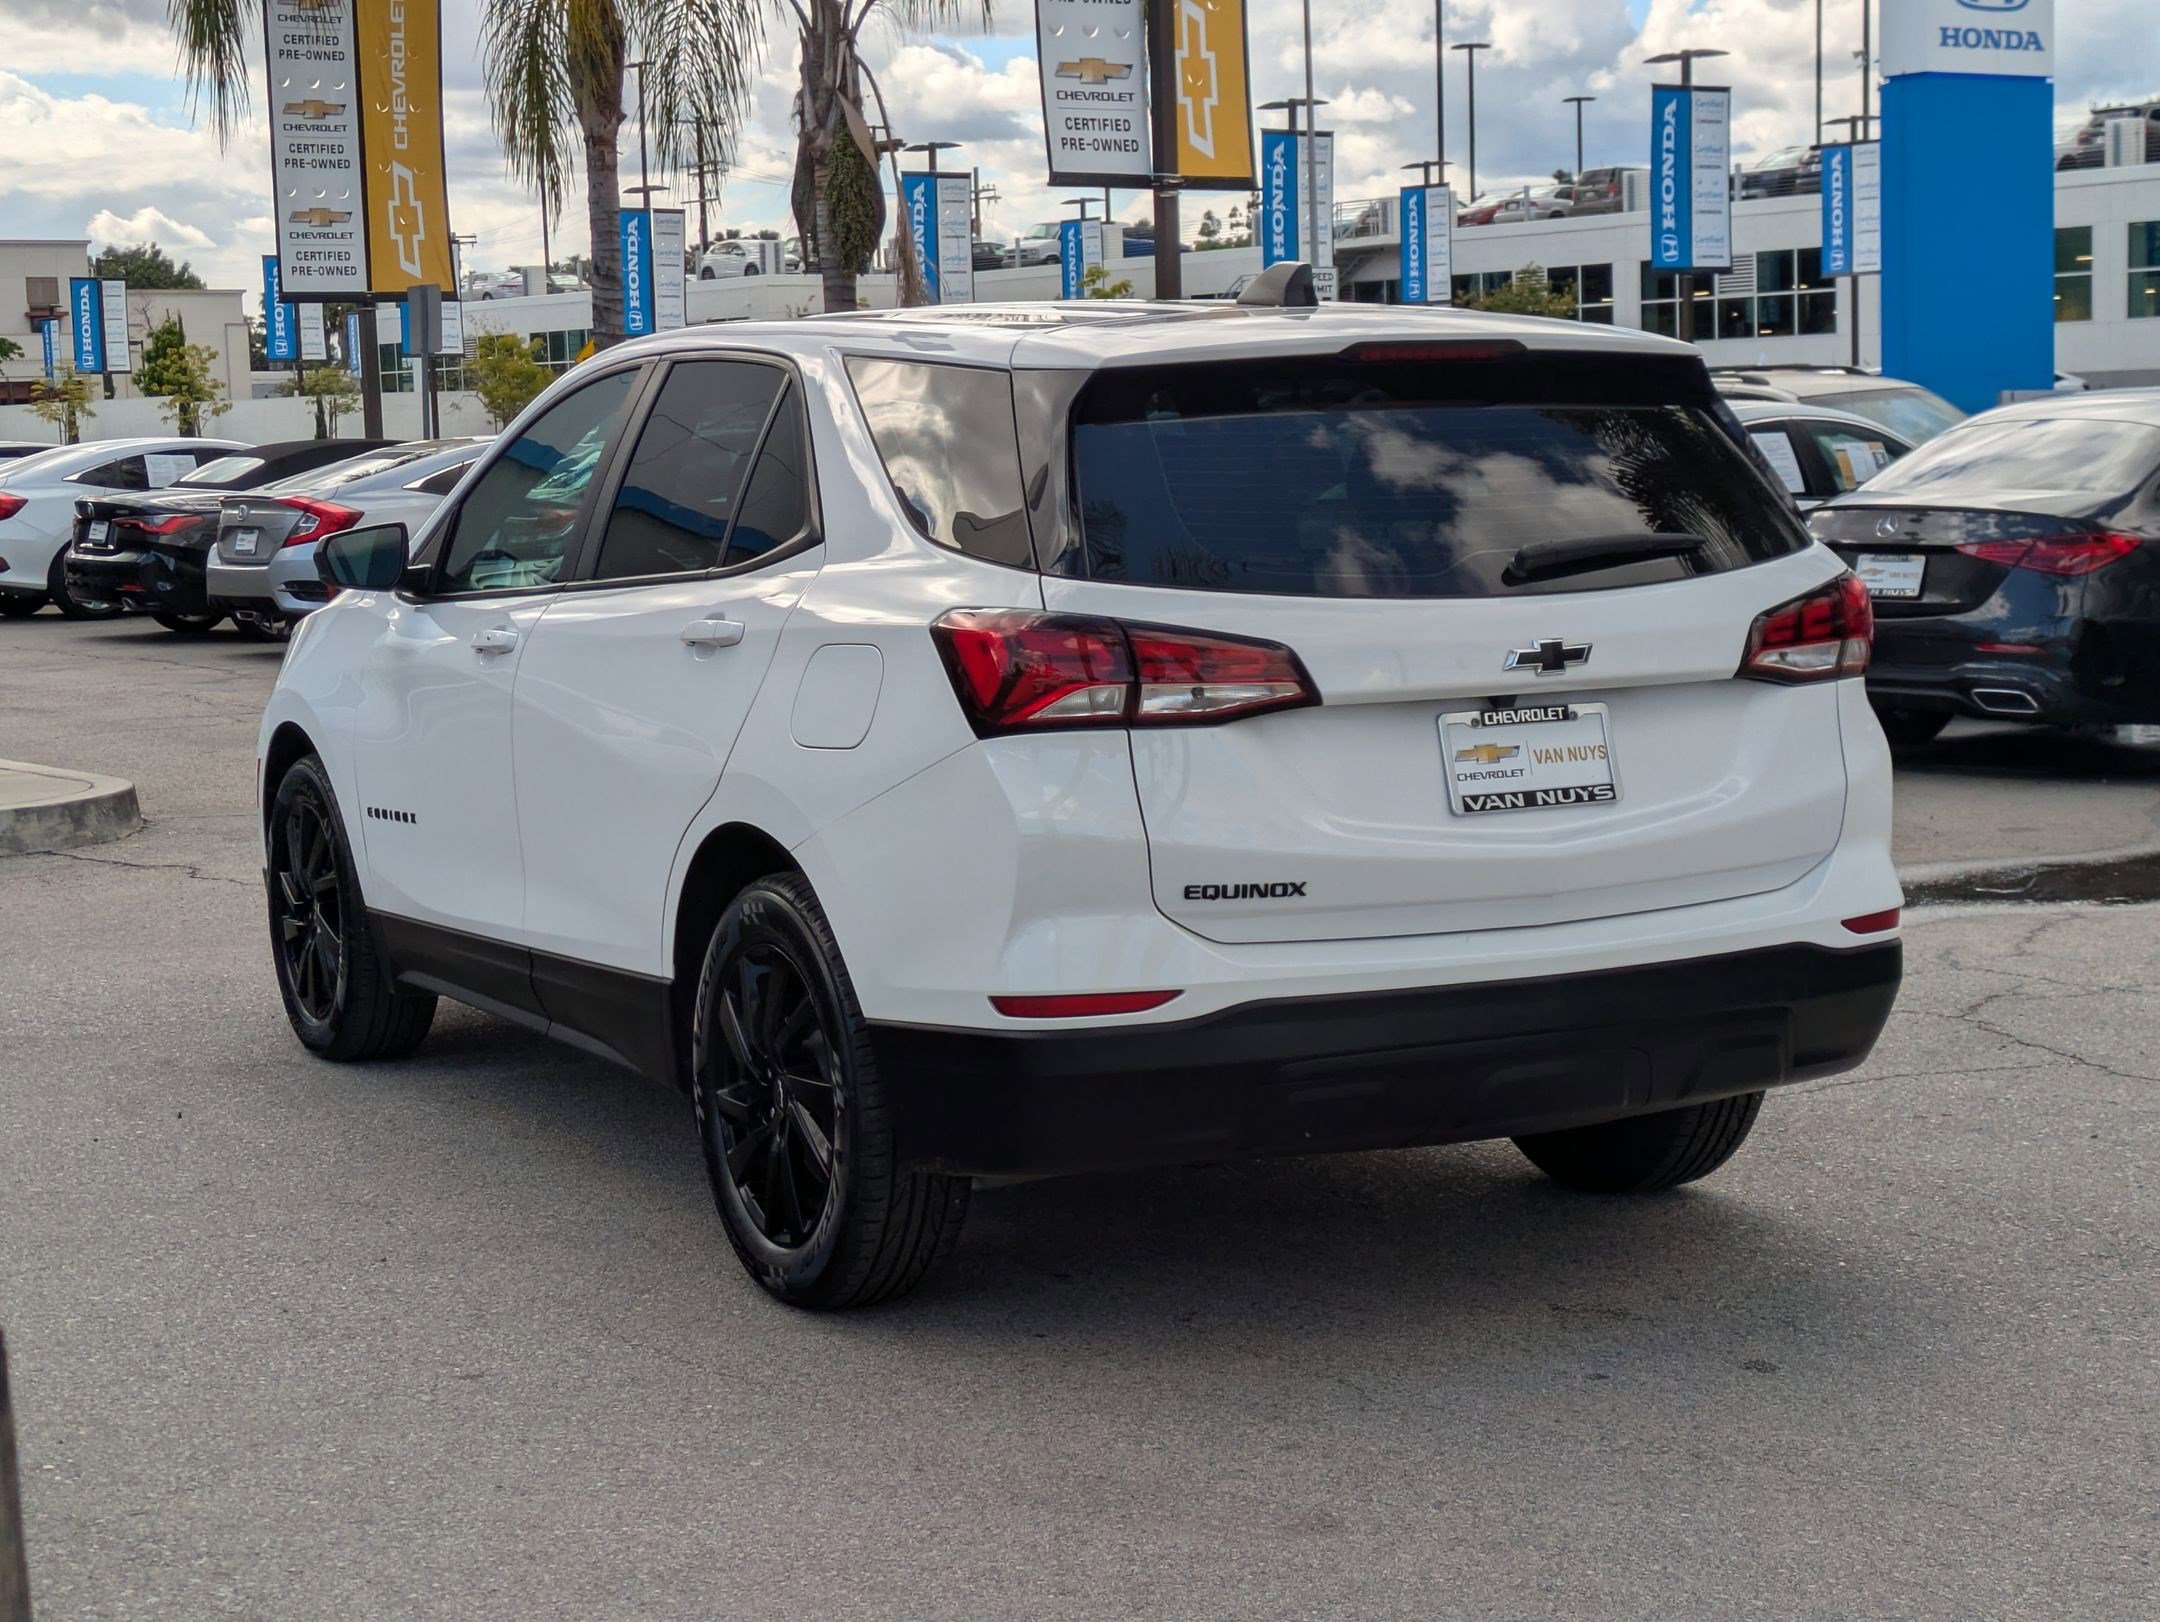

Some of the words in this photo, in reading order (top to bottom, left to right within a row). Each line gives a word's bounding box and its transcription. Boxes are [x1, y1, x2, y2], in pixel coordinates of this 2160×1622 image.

[277, 13, 343, 24] CHEVROLET
[283, 34, 339, 46] CERTIFIED
[1938, 26, 2045, 52] HONDA
[279, 49, 345, 61] PRE-OWNED
[390, 0, 408, 150] CHEVROLE
[1056, 90, 1135, 102] CHEVROLET
[283, 123, 347, 132] CHEVROLET
[1065, 117, 1131, 132] CERTIFIED
[289, 143, 344, 155] CERTIFIED
[1061, 137, 1139, 153] PRE-OWNED
[284, 158, 351, 169] PRE-OWNED
[1661, 98, 1677, 231] HONDA
[1272, 141, 1285, 258] HONDA
[1831, 151, 1843, 247] HONDA
[289, 231, 355, 240] CHEVROLET
[1408, 194, 1419, 277] HONDA
[295, 250, 351, 261] CERTIFIED
[627, 216, 640, 309] HONDA
[291, 265, 357, 276] PRE-OWNED
[80, 284, 92, 352] HONDA
[1484, 707, 1565, 725] CHEVROLET
[1533, 748, 1563, 764] VAN
[1568, 744, 1608, 762] NUYS
[1457, 768, 1525, 782] CHEVROLET
[1464, 793, 1525, 811] VAN
[1536, 785, 1614, 806] NUYS
[366, 806, 417, 825] EQUINOX
[1183, 881, 1308, 901] EQUINOX
